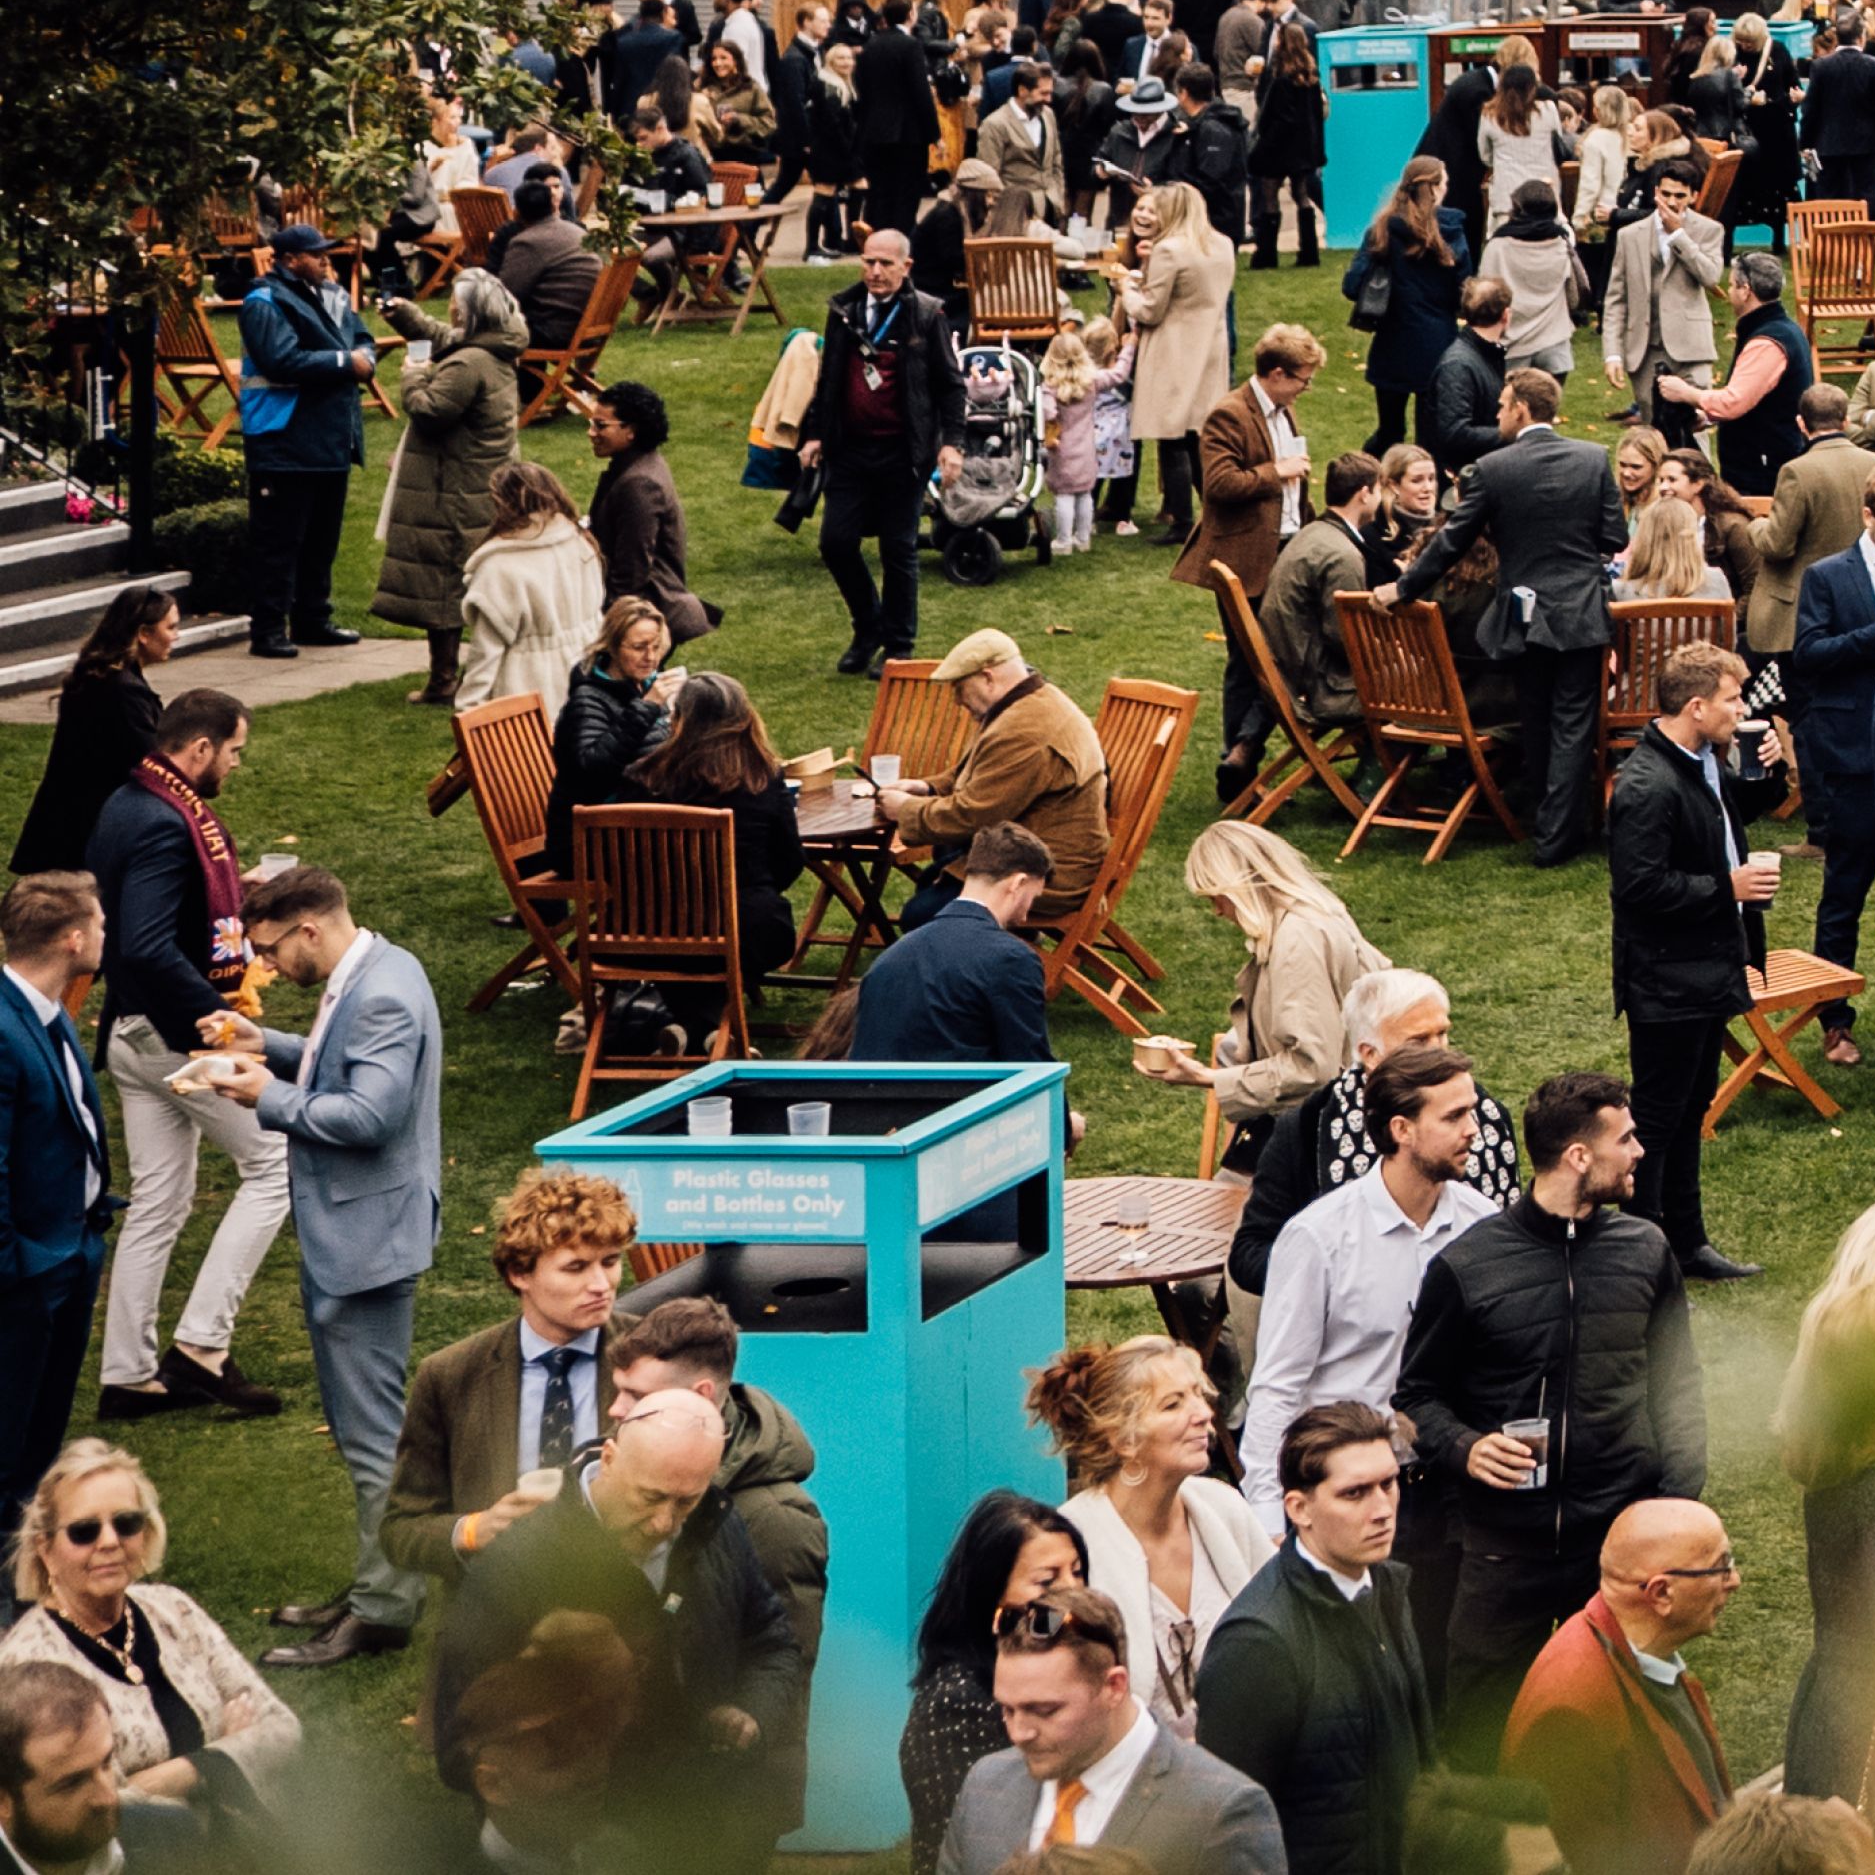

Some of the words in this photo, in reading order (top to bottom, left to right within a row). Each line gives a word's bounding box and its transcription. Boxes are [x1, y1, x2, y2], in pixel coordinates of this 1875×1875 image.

[672, 1168, 741, 1189] Plastic
[747, 1168, 830, 1189] Glasses
[665, 1194, 707, 1213] and
[713, 1194, 786, 1214] Bottles
[793, 1193, 846, 1218] Only
